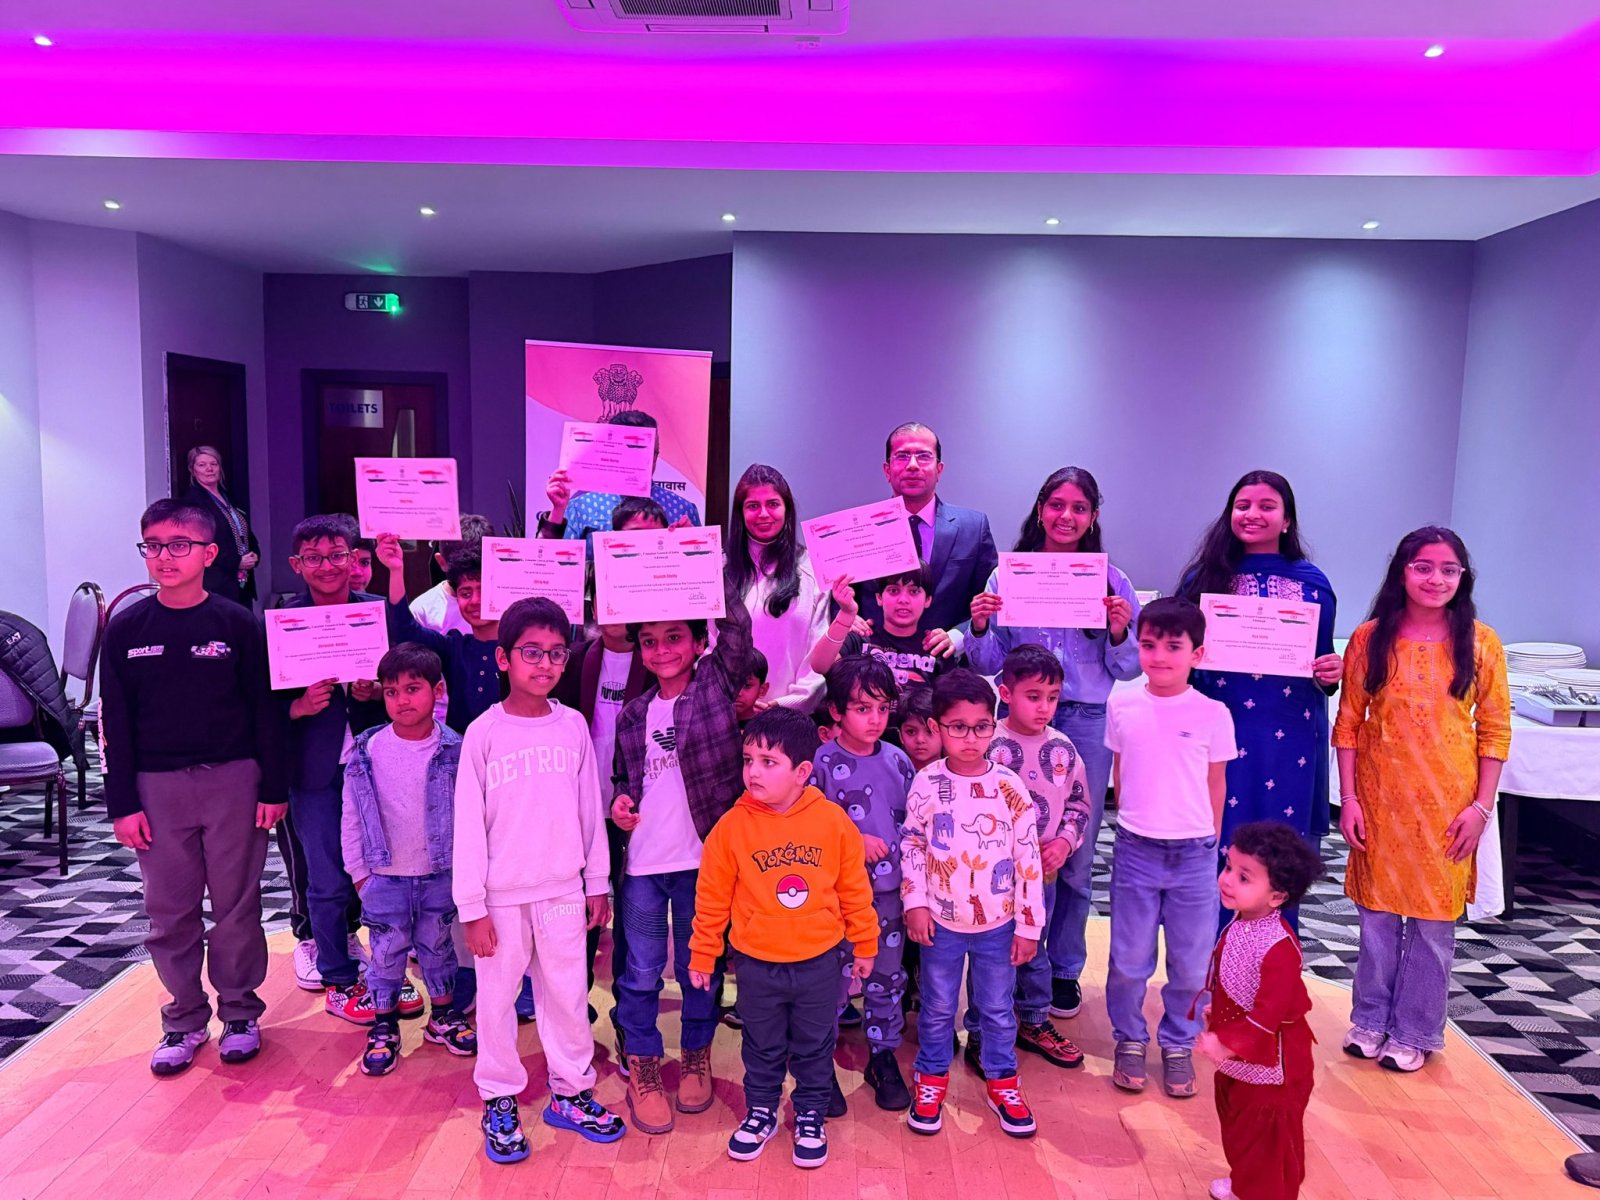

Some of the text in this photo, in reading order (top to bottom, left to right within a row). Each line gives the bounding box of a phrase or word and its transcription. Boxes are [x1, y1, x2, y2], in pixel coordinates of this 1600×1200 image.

[328, 402, 378, 414] TOILETS
[6, 631, 21, 645] EA7
[542, 902, 583, 925] DETROIT
